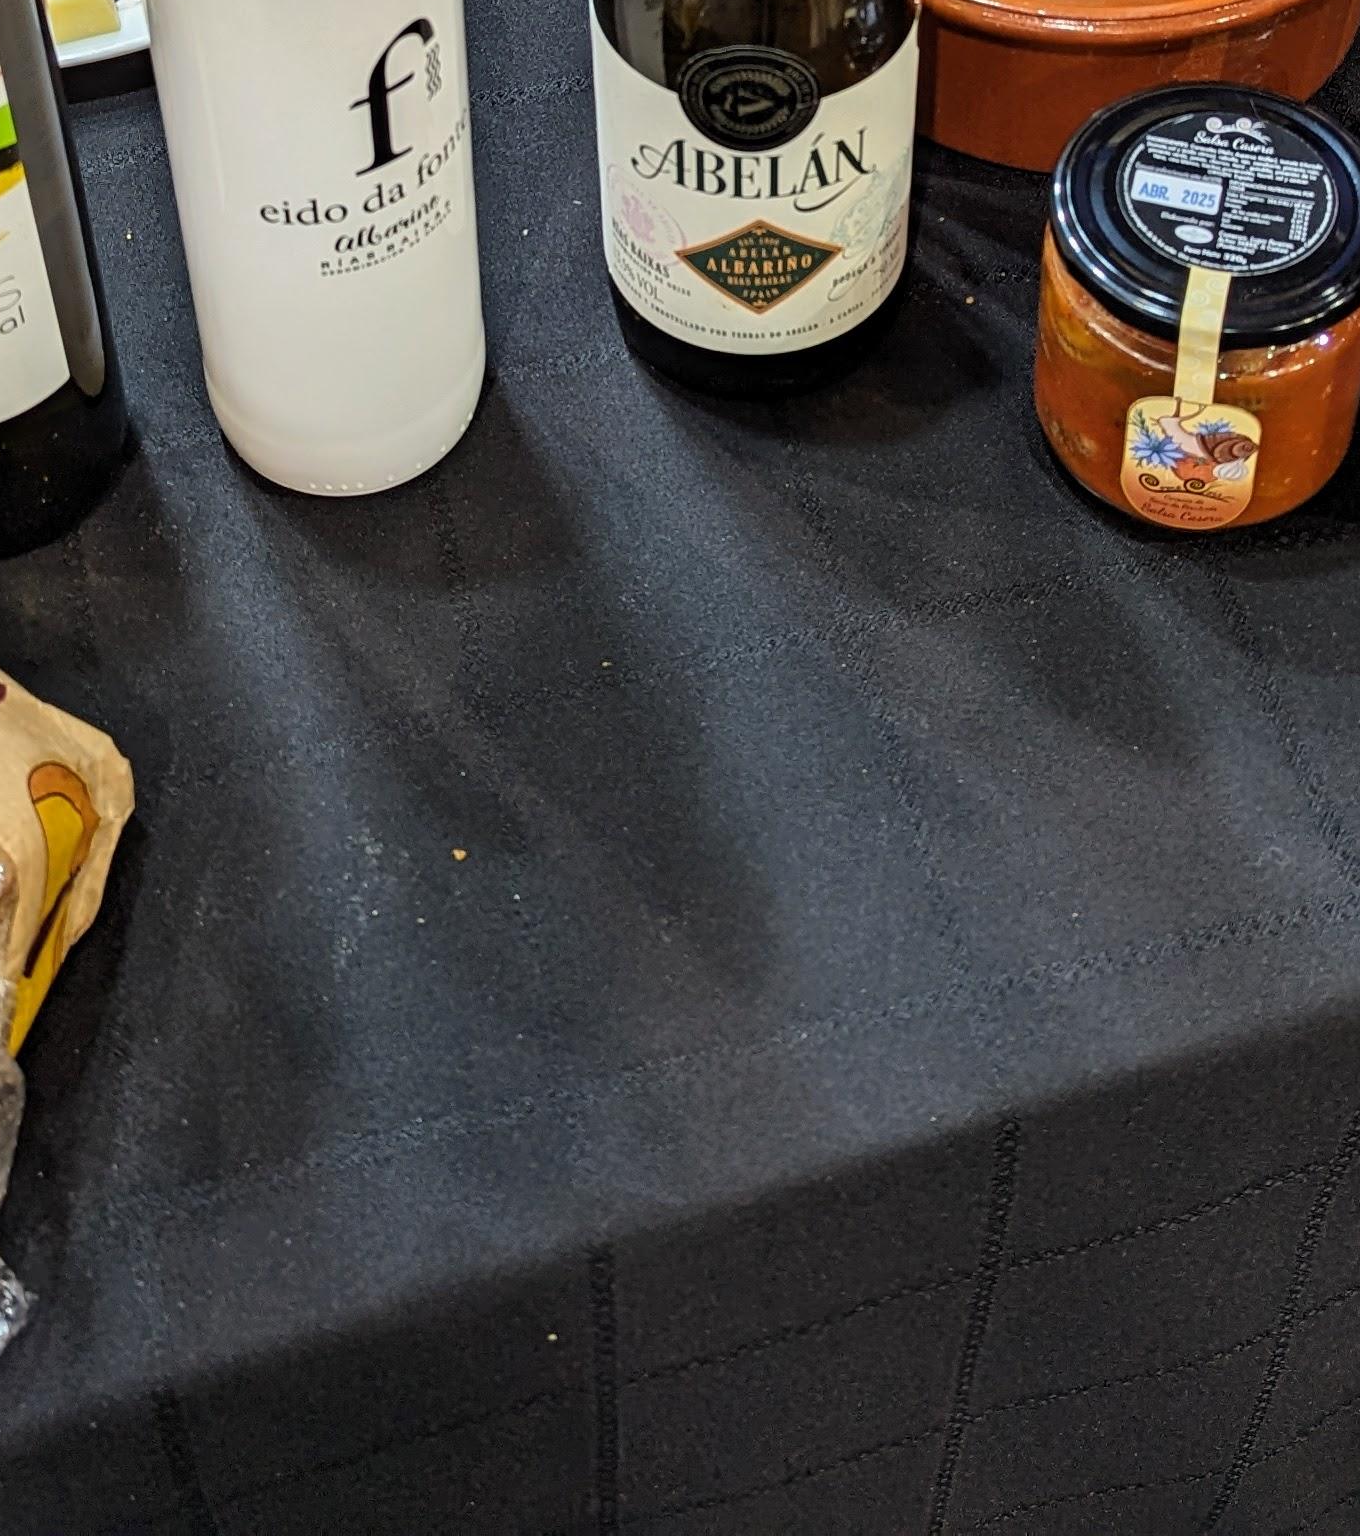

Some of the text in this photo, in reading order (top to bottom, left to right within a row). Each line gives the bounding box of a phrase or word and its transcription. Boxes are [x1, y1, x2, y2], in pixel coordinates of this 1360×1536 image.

[1193, 130, 1275, 155] Salsa Casera
[259, 198, 349, 227] eido
[362, 183, 406, 214] da
[1181, 189, 1216, 208] 2025
